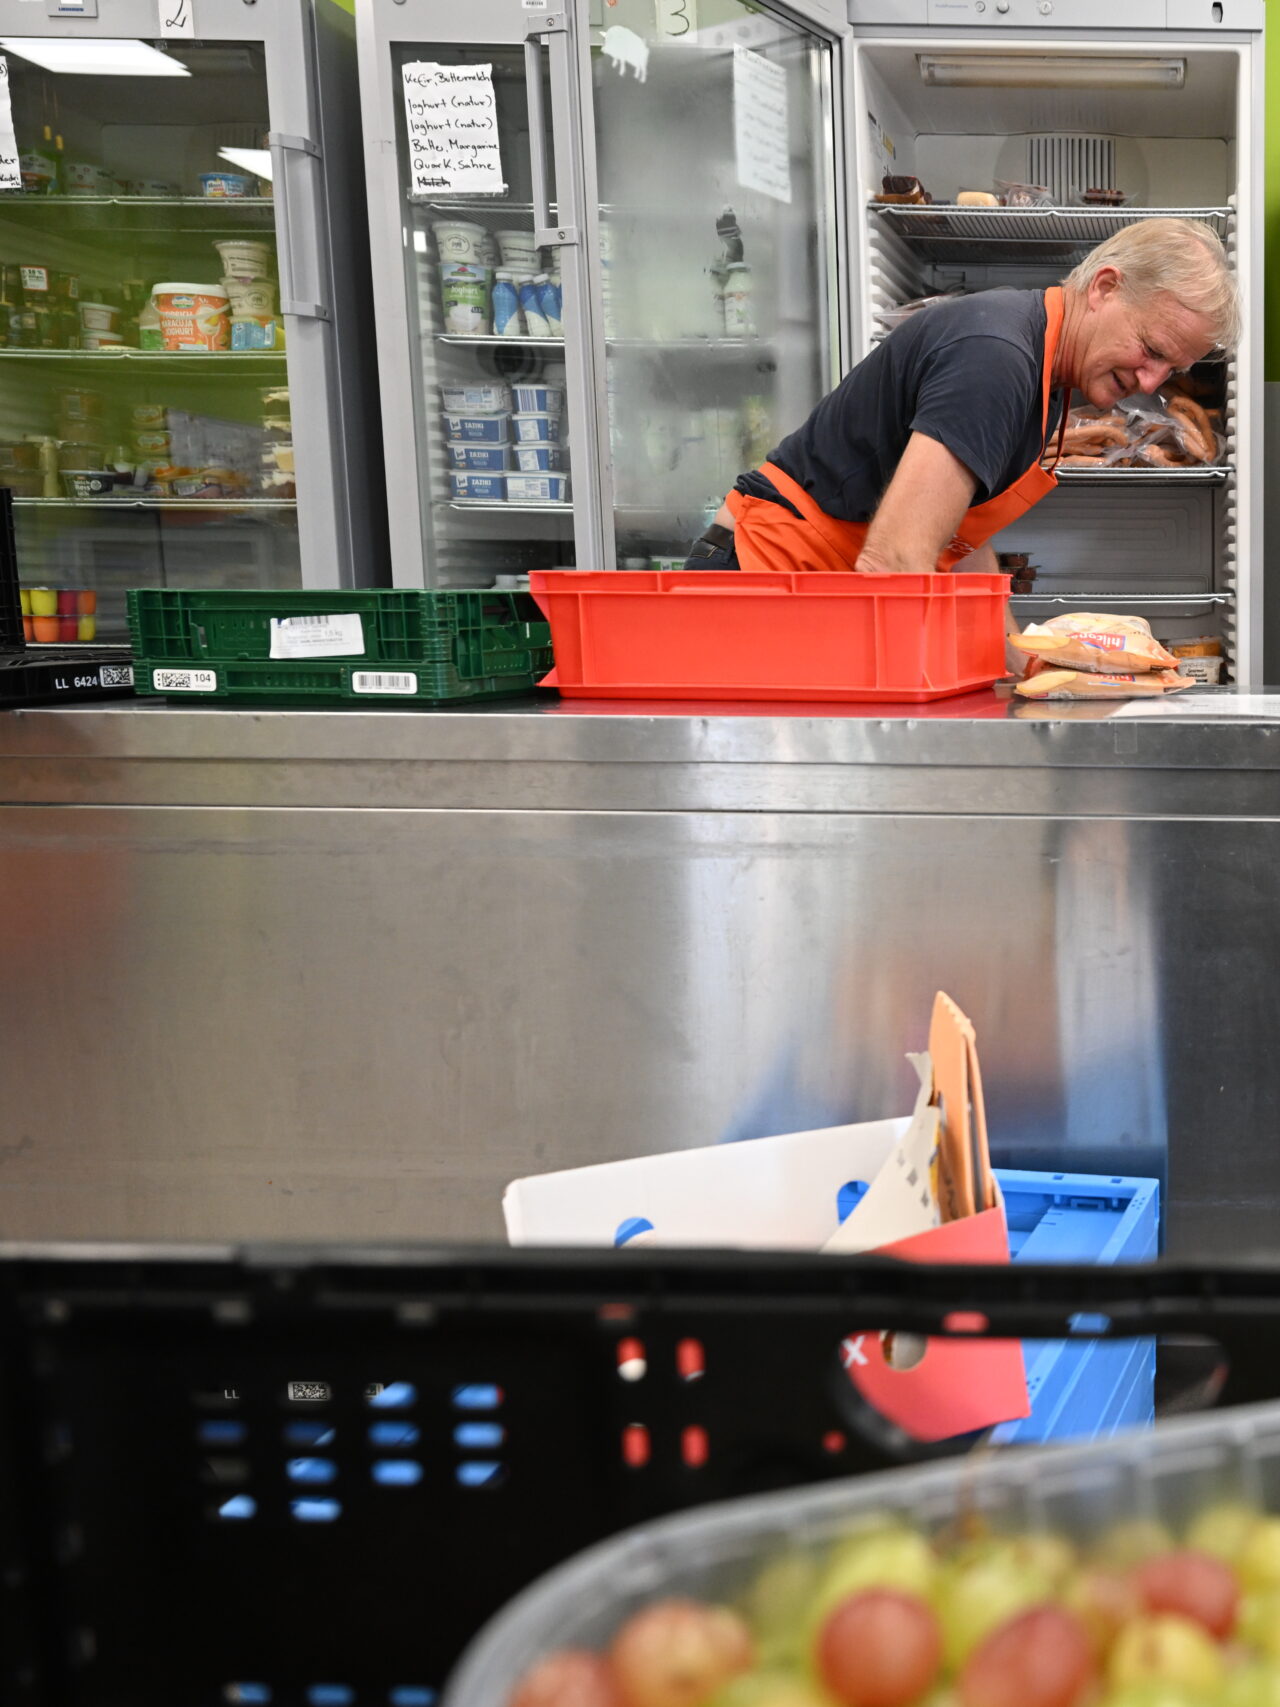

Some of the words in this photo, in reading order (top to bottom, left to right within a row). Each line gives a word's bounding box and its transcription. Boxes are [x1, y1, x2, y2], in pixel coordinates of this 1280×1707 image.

[165, 0, 187, 28] 2
[666, 0, 690, 36] 3
[55, 677, 70, 690] LL
[74, 676, 98, 688] 6424
[194, 673, 211, 682] 104
